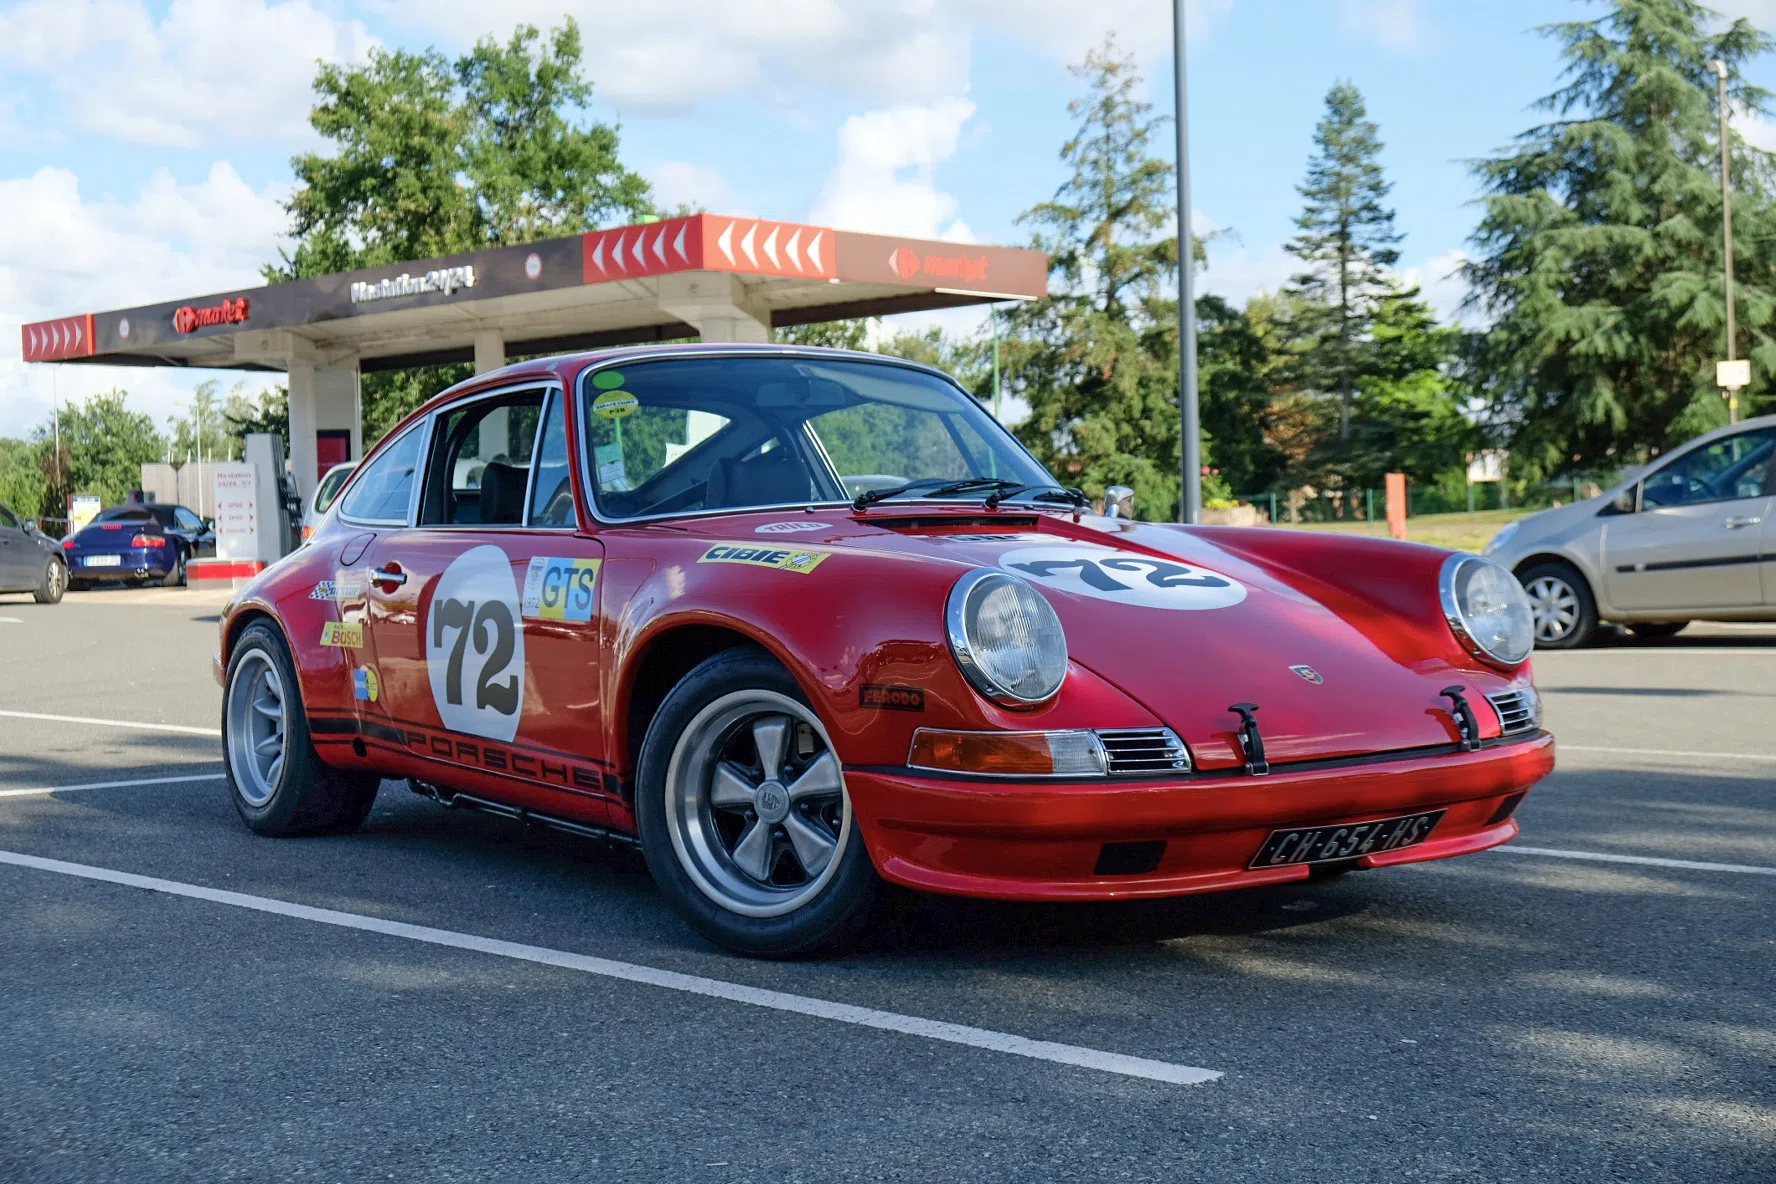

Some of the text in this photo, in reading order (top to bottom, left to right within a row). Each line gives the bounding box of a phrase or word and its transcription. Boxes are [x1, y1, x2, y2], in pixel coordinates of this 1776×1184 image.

[194, 297, 249, 327] market
[764, 522, 822, 532] TRICO
[705, 546, 790, 564] CIBIE
[542, 566, 594, 611] GTS
[1009, 557, 1231, 591] 72
[523, 596, 540, 609] 1972
[331, 630, 361, 646] BOSCH
[433, 597, 519, 716] 72
[863, 689, 921, 706] FERODO
[406, 730, 601, 790] PORSCHE
[1270, 816, 1429, 864] CH-654-HS
